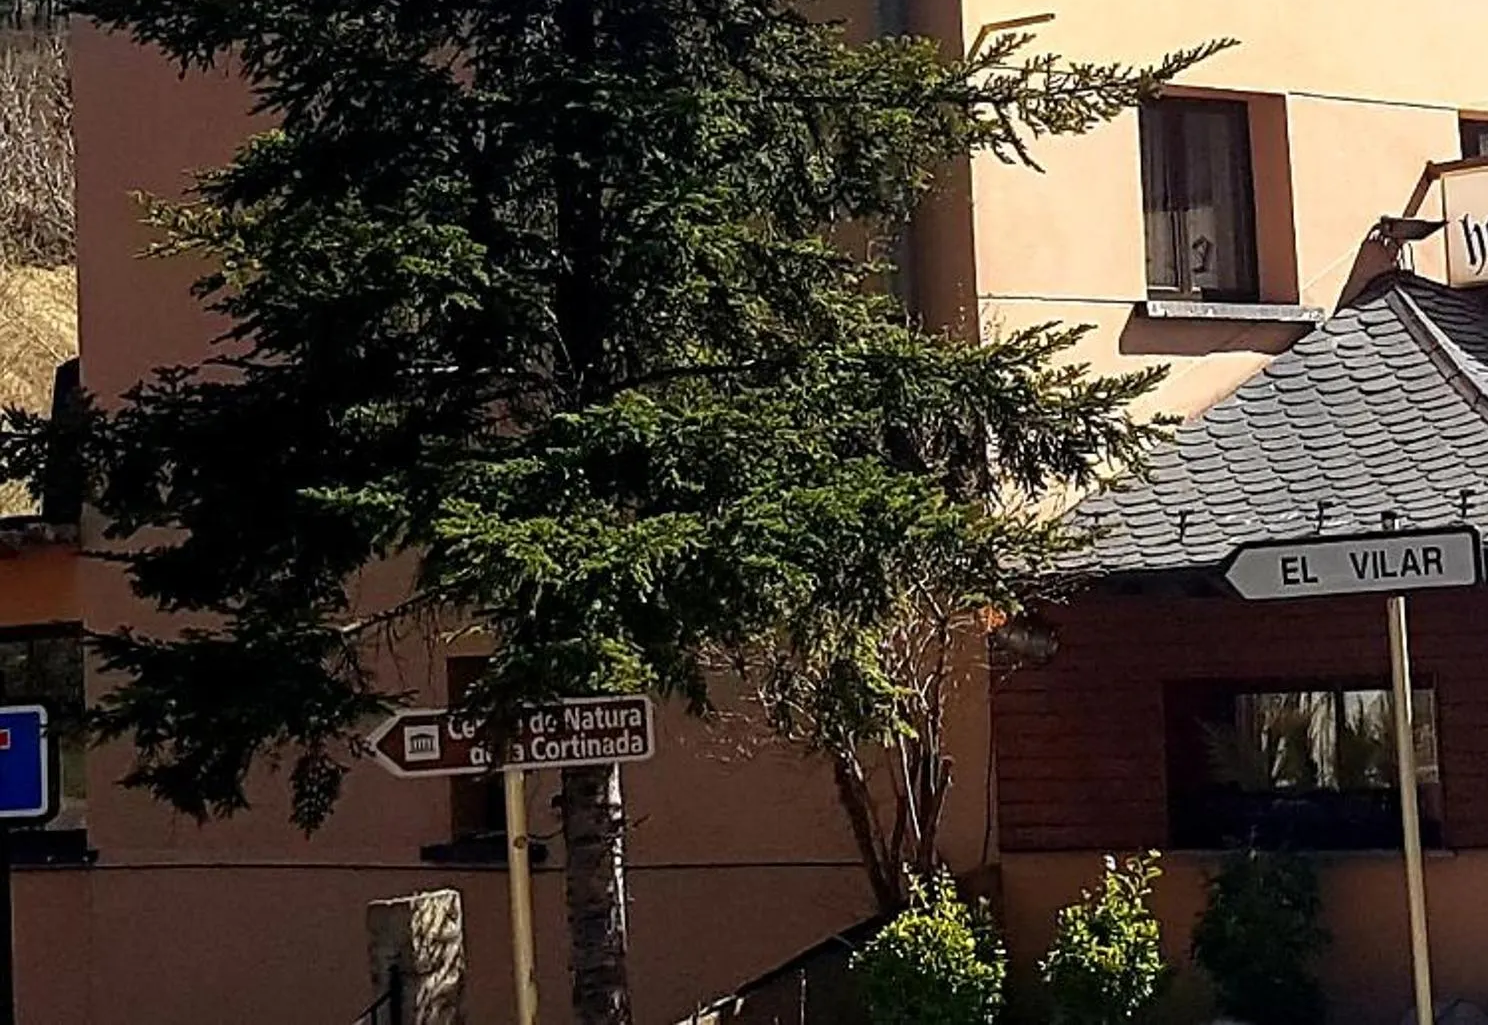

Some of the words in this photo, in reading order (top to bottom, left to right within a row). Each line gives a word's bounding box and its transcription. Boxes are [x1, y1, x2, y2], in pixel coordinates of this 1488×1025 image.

[1281, 555, 1318, 586] EL
[1350, 546, 1444, 580] VILAR
[565, 706, 641, 732] Natura
[531, 729, 643, 760] Cortinada
